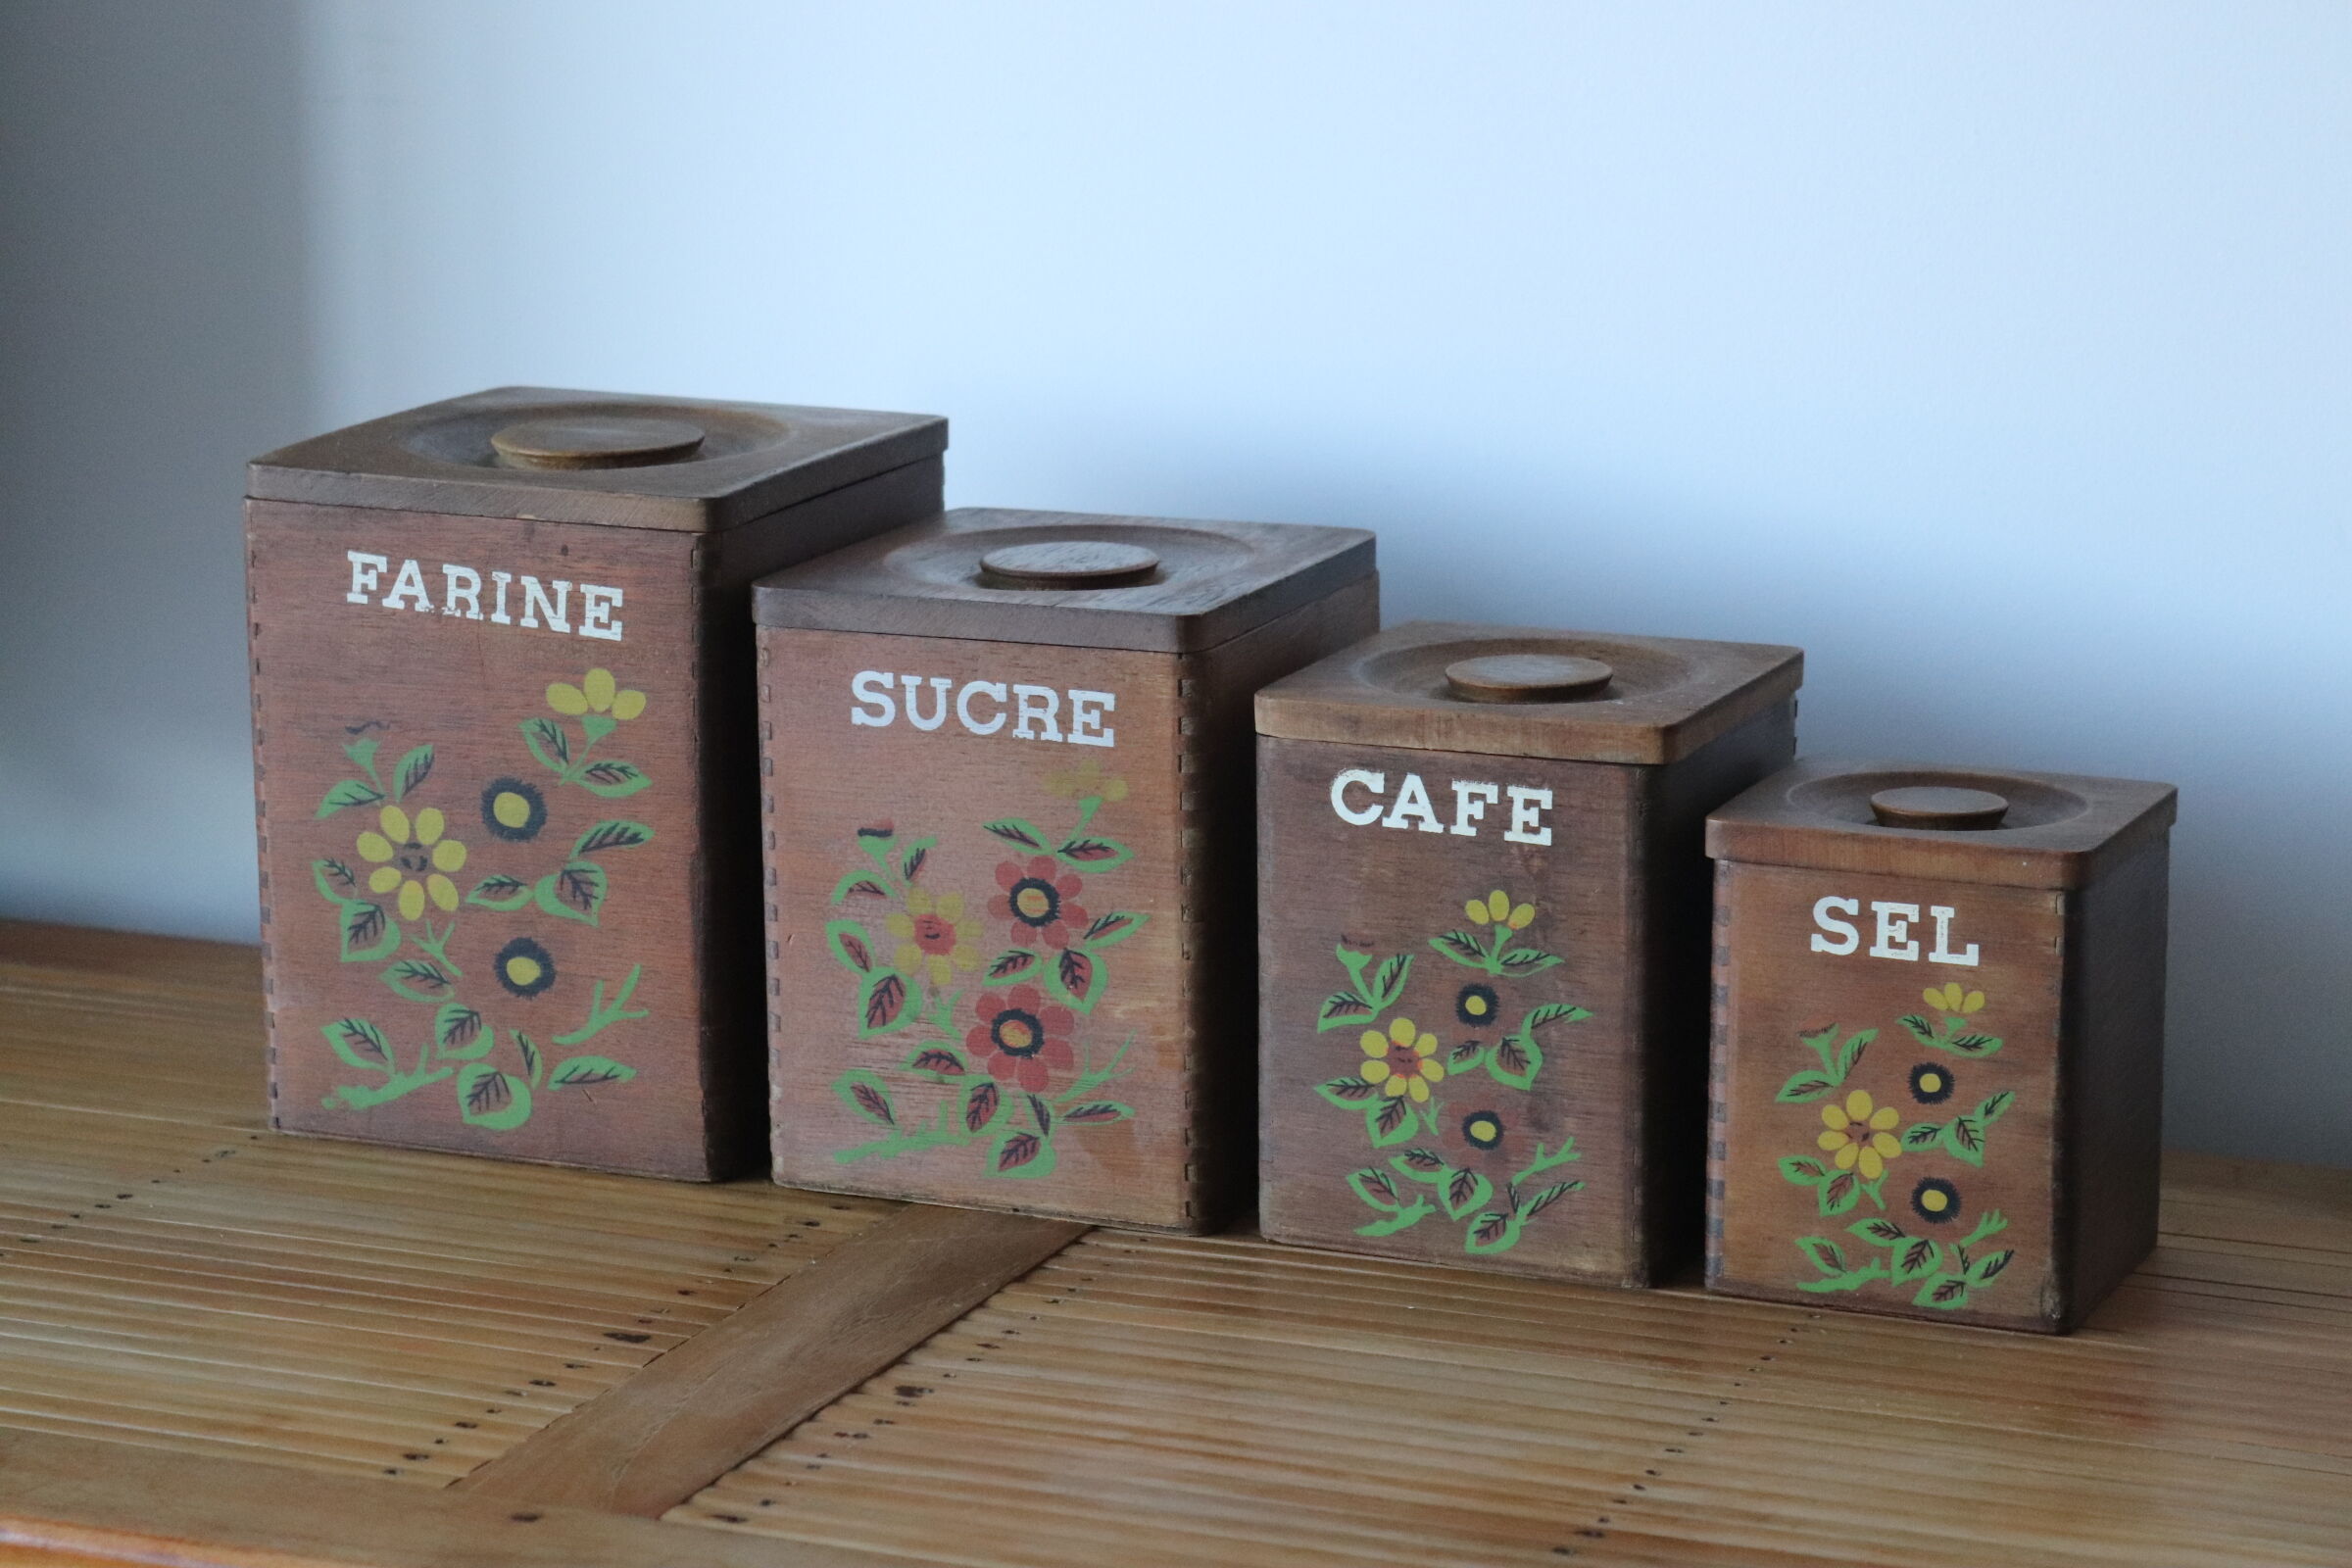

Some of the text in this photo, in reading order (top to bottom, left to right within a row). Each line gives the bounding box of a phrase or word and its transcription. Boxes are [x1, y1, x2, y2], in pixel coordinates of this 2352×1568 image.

[344, 549, 624, 642] FARINE
[849, 667, 1116, 748] SUCRE
[1329, 767, 1553, 847] CAFE
[1810, 895, 1980, 967] SEL
